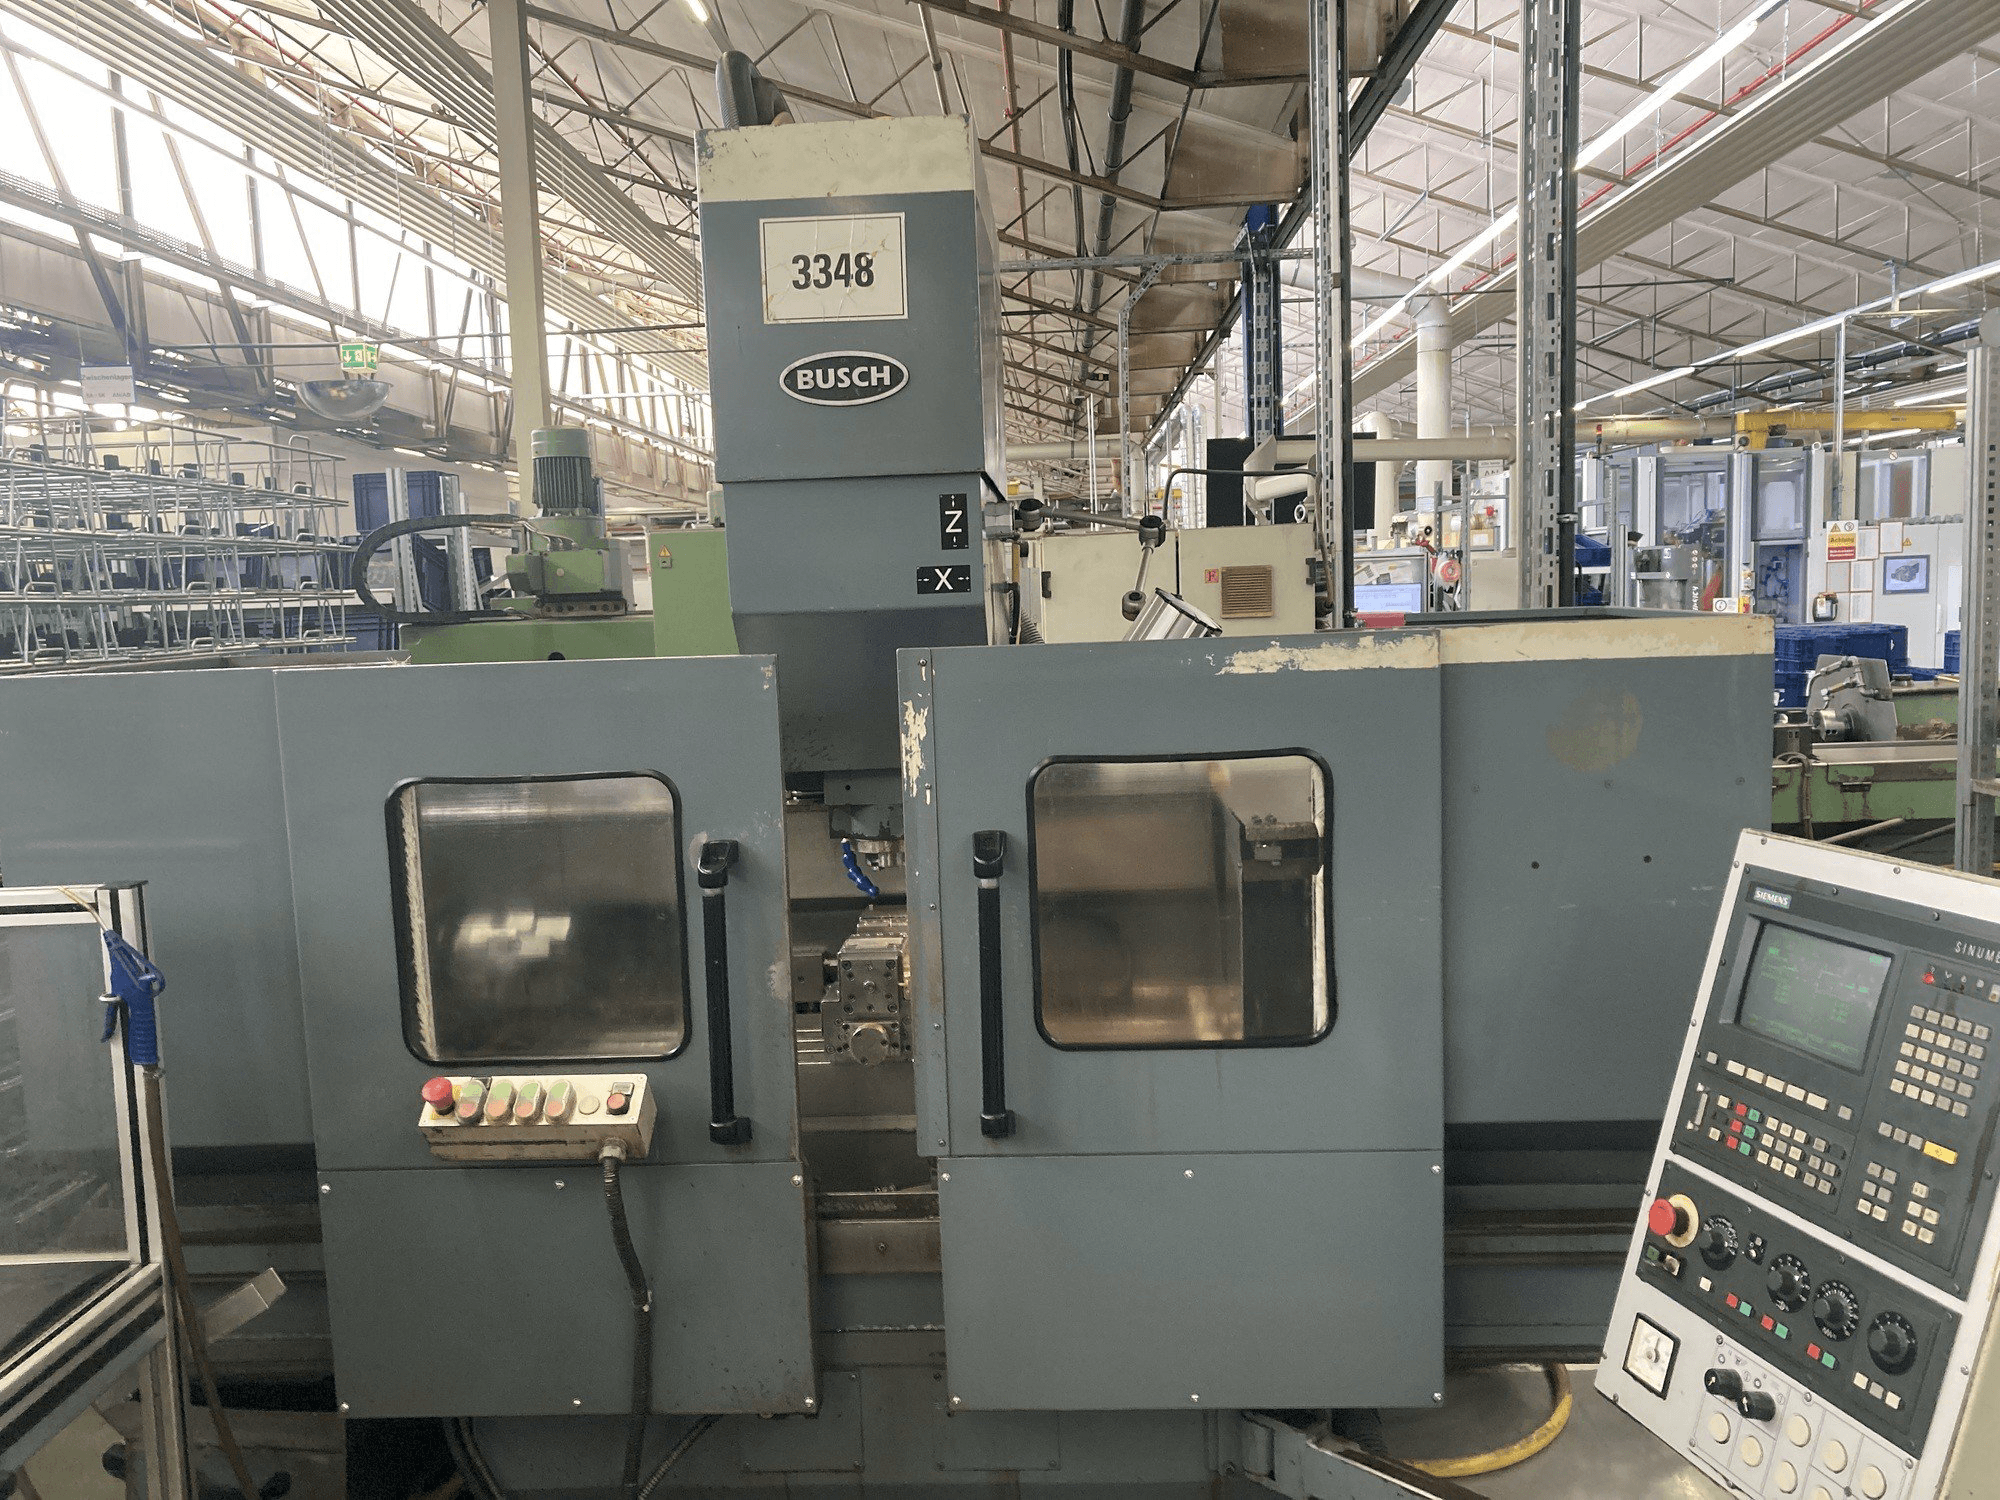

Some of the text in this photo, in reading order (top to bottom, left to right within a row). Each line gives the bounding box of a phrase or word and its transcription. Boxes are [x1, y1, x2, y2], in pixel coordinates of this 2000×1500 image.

[791, 252, 875, 290] 3348
[796, 365, 891, 390] BUSCH
[944, 510, 963, 533] Z
[934, 567, 954, 591] X
[1755, 890, 1789, 906] SIEMENS
